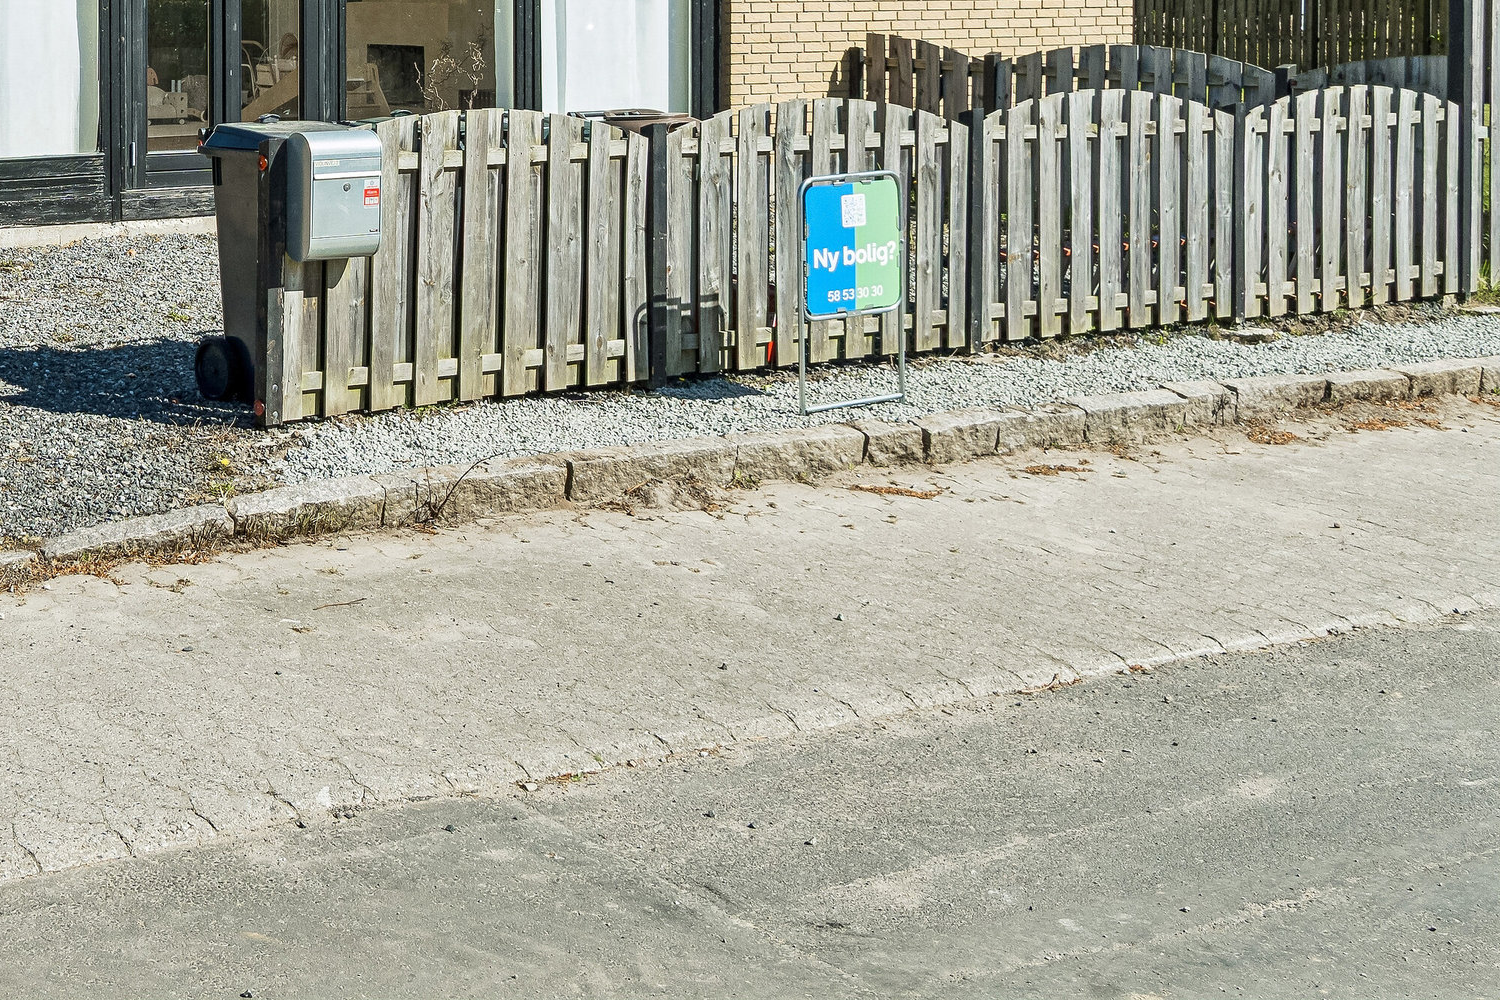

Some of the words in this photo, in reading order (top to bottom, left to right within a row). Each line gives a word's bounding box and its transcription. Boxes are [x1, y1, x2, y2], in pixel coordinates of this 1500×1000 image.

[813, 248, 839, 272] Ny
[843, 241, 896, 266] bolig?
[827, 290, 840, 302] 58
[842, 289, 855, 300] 53
[857, 287, 869, 298] 30
[871, 285, 883, 296] 30
